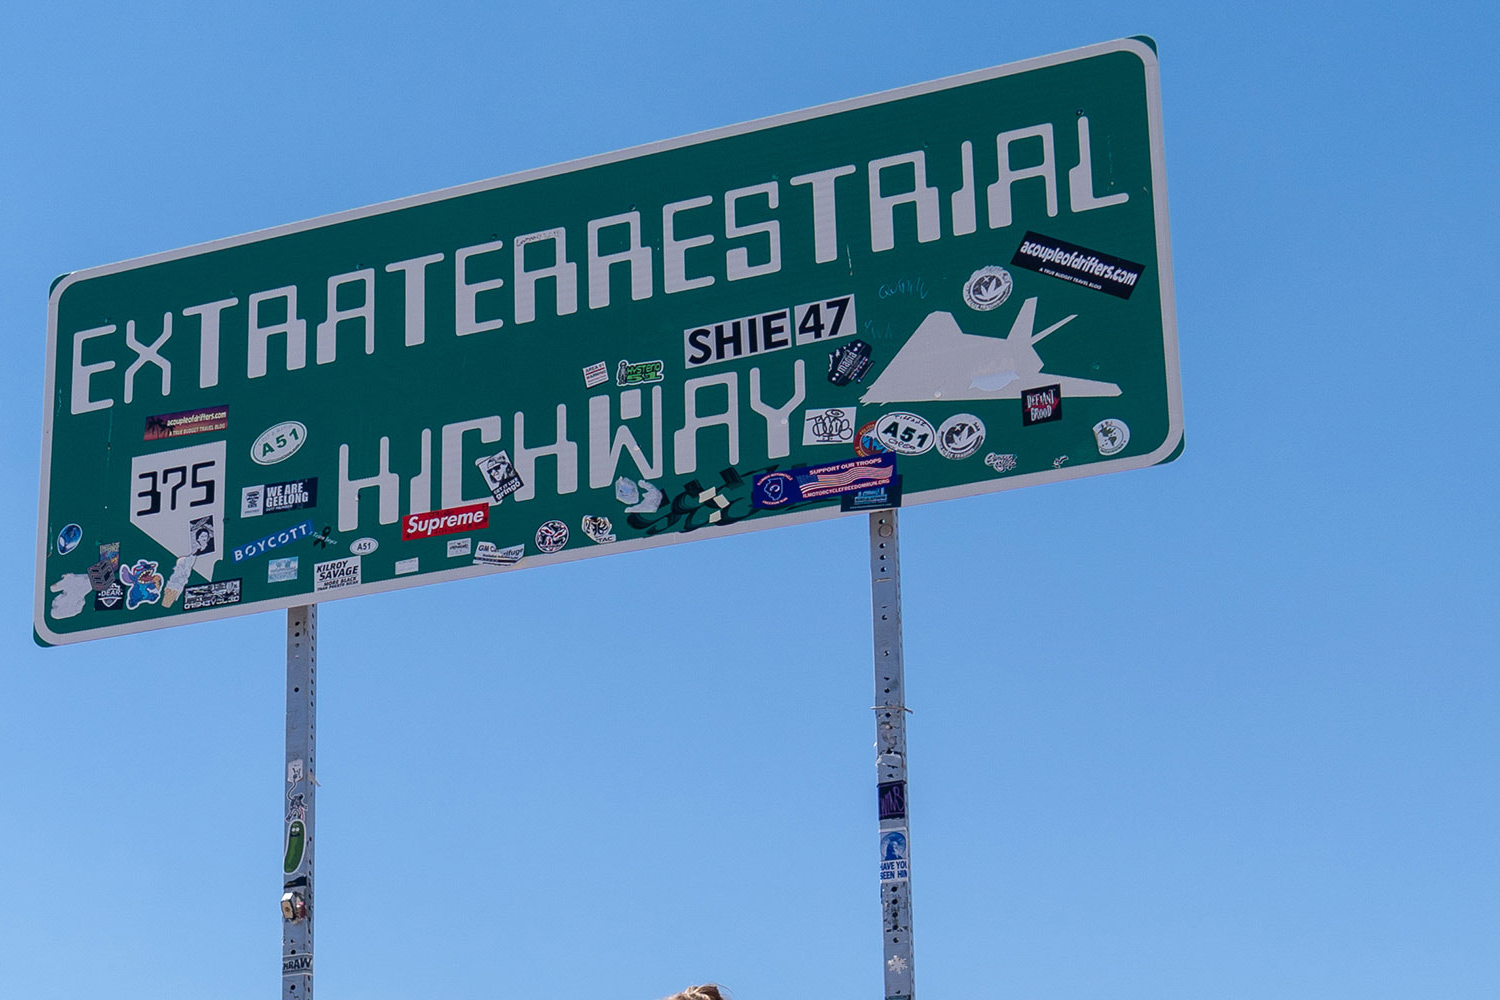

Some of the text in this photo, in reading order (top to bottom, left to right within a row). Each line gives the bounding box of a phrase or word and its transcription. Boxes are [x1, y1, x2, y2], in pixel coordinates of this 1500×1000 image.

[70, 115, 1130, 415] EXTRATERRESTRIAL
[1020, 241, 1138, 286] acoupleofdrifters.com
[688, 311, 789, 365] SHIE
[798, 296, 851, 340] 47
[261, 427, 299, 458] A51
[337, 358, 806, 532] HIGHWAY
[882, 420, 930, 449] A51
[809, 465, 840, 476] SUPPORT
[854, 458, 882, 467] TROOPS
[136, 460, 216, 517] 375
[266, 482, 304, 498] WE ARE
[266, 491, 309, 508] GEELONG
[407, 510, 484, 536] Supreme
[234, 524, 307, 562] BOYCOTT
[357, 542, 371, 551] A51
[316, 560, 348, 573] KILROY
[319, 565, 359, 581] SAVAGE
